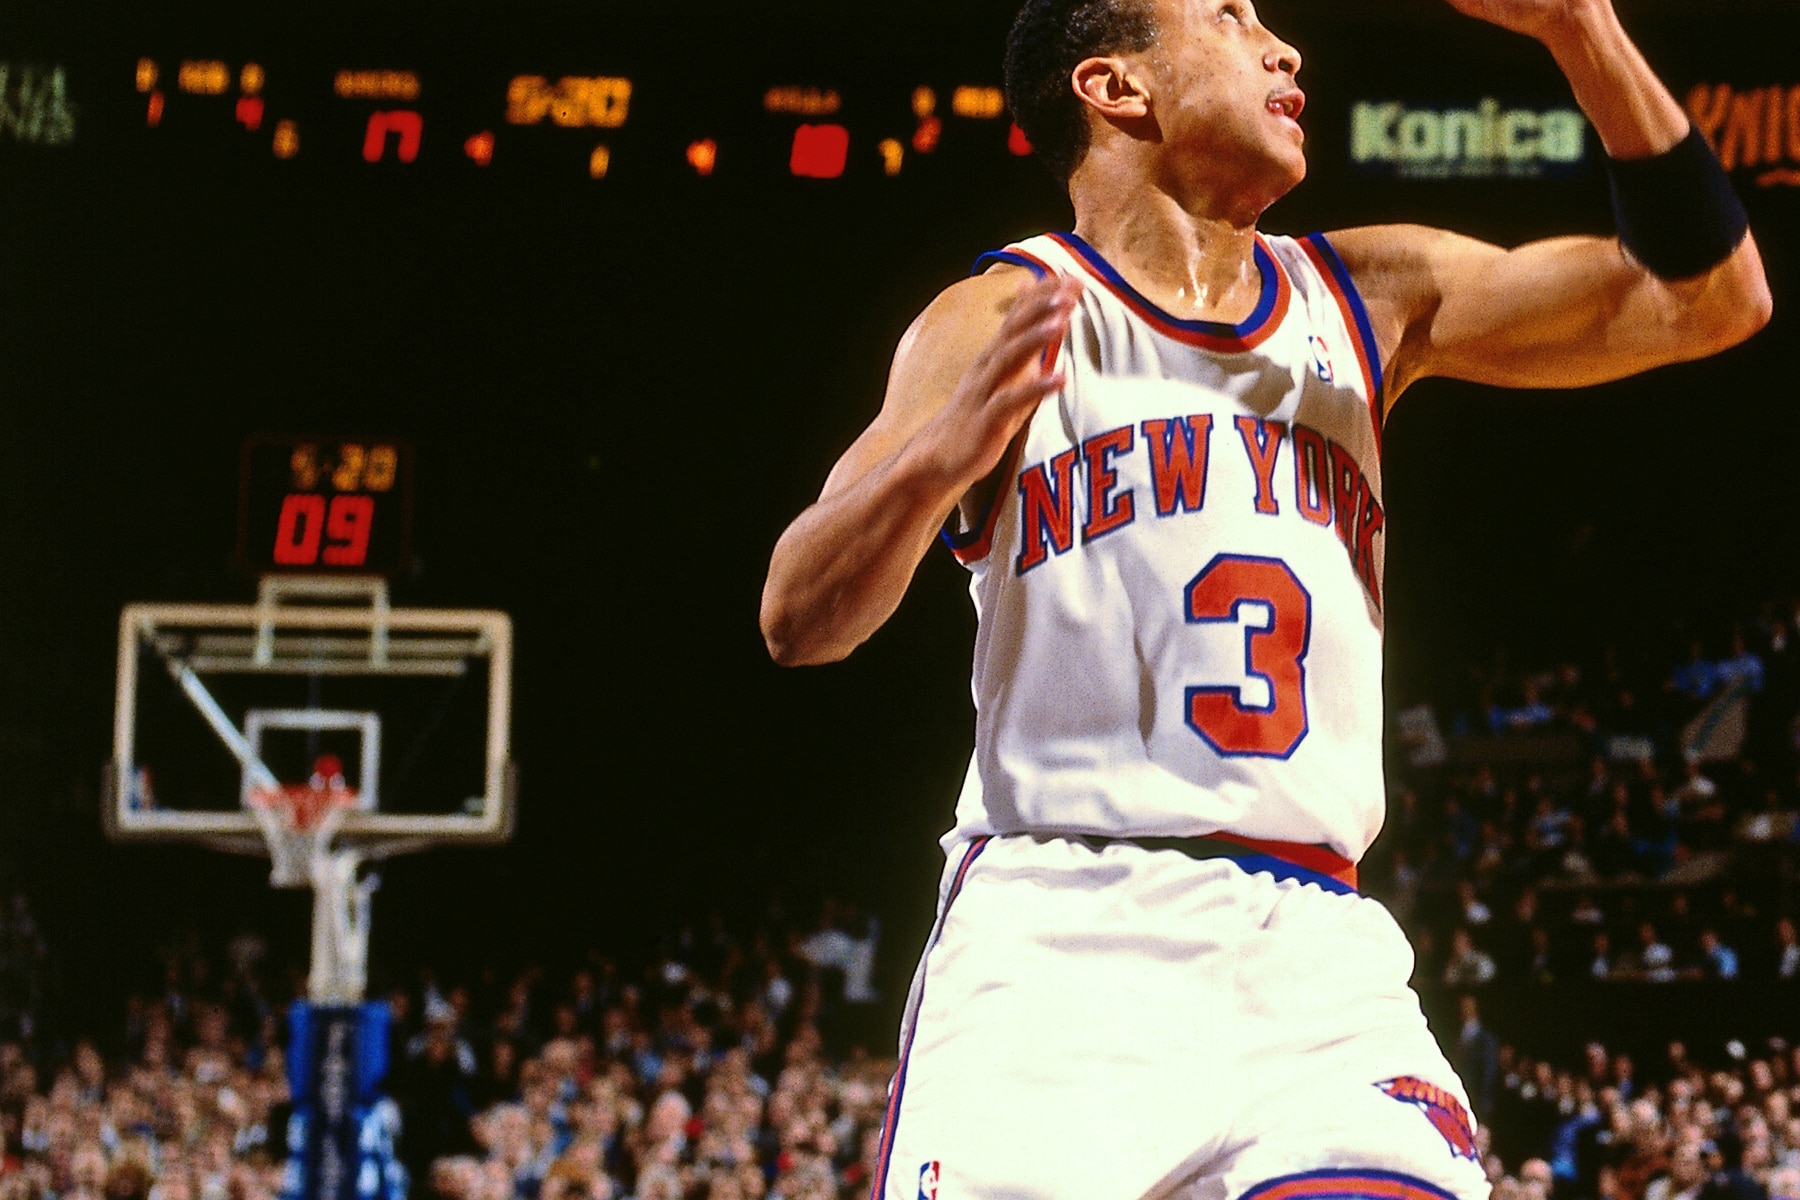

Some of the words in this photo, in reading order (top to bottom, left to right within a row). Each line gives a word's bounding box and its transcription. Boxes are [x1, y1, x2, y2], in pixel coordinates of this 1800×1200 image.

[1351, 98, 1584, 162] Konica
[273, 493, 375, 567] 09
[1016, 414, 1213, 576] NEW
[1233, 414, 1385, 614] YORK
[1184, 553, 1311, 759] 3
